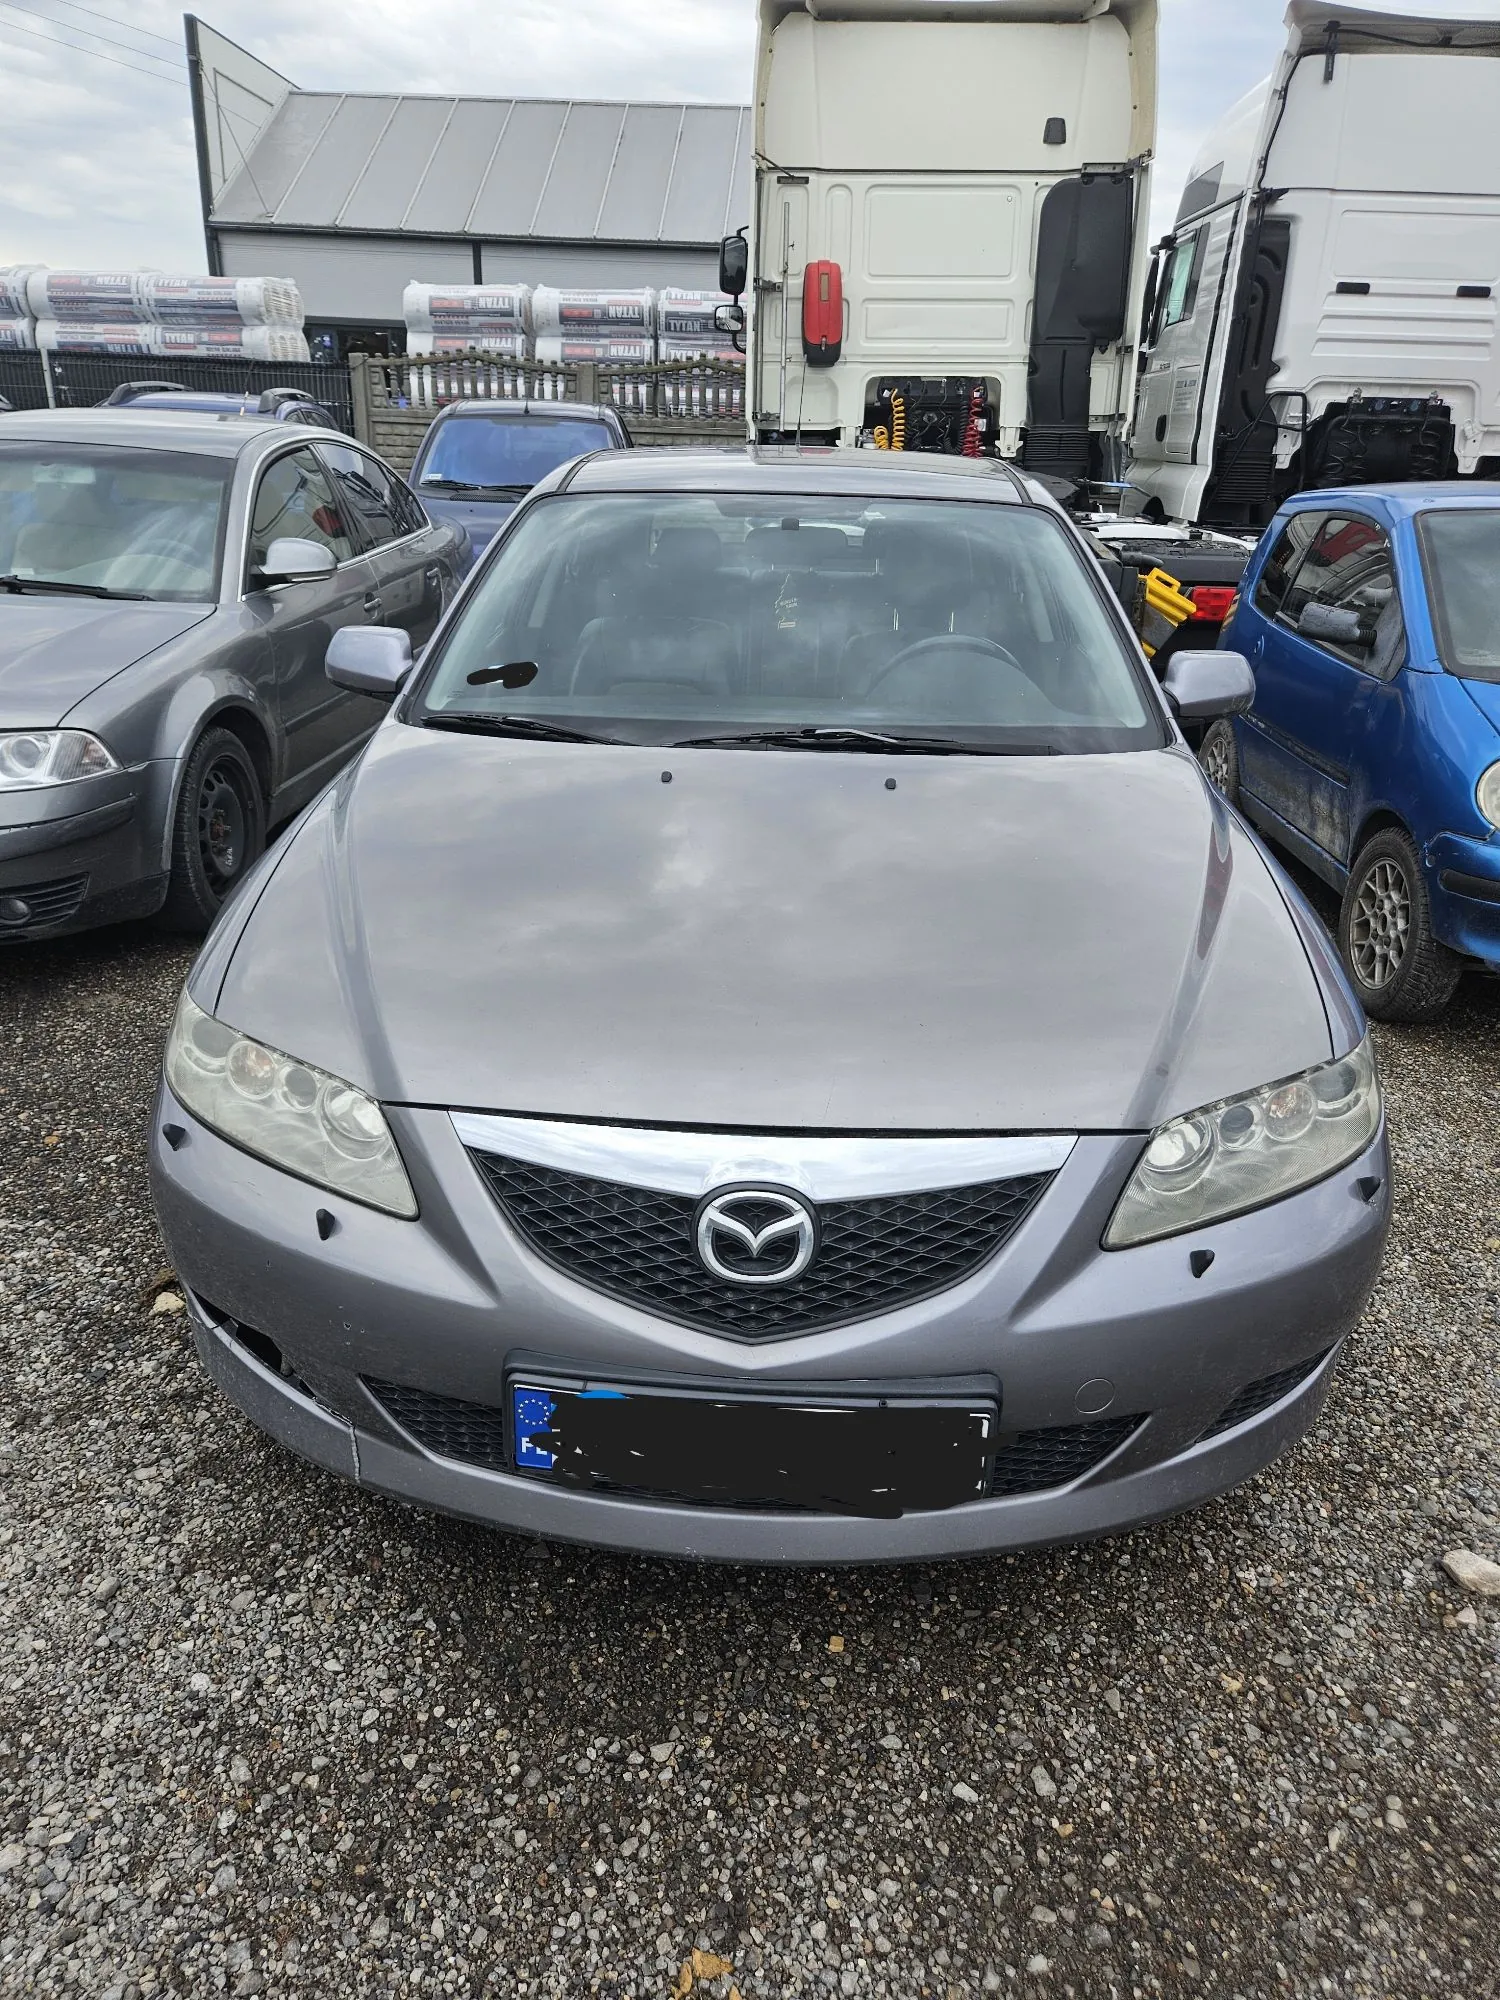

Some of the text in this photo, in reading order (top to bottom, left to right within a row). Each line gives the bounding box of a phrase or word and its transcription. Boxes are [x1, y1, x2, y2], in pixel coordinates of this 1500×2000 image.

[479, 297, 510, 308] TYTAN
[608, 306, 640, 318] TYTAN
[669, 320, 700, 332] TYTAN
[610, 345, 640, 357] TYTAN
